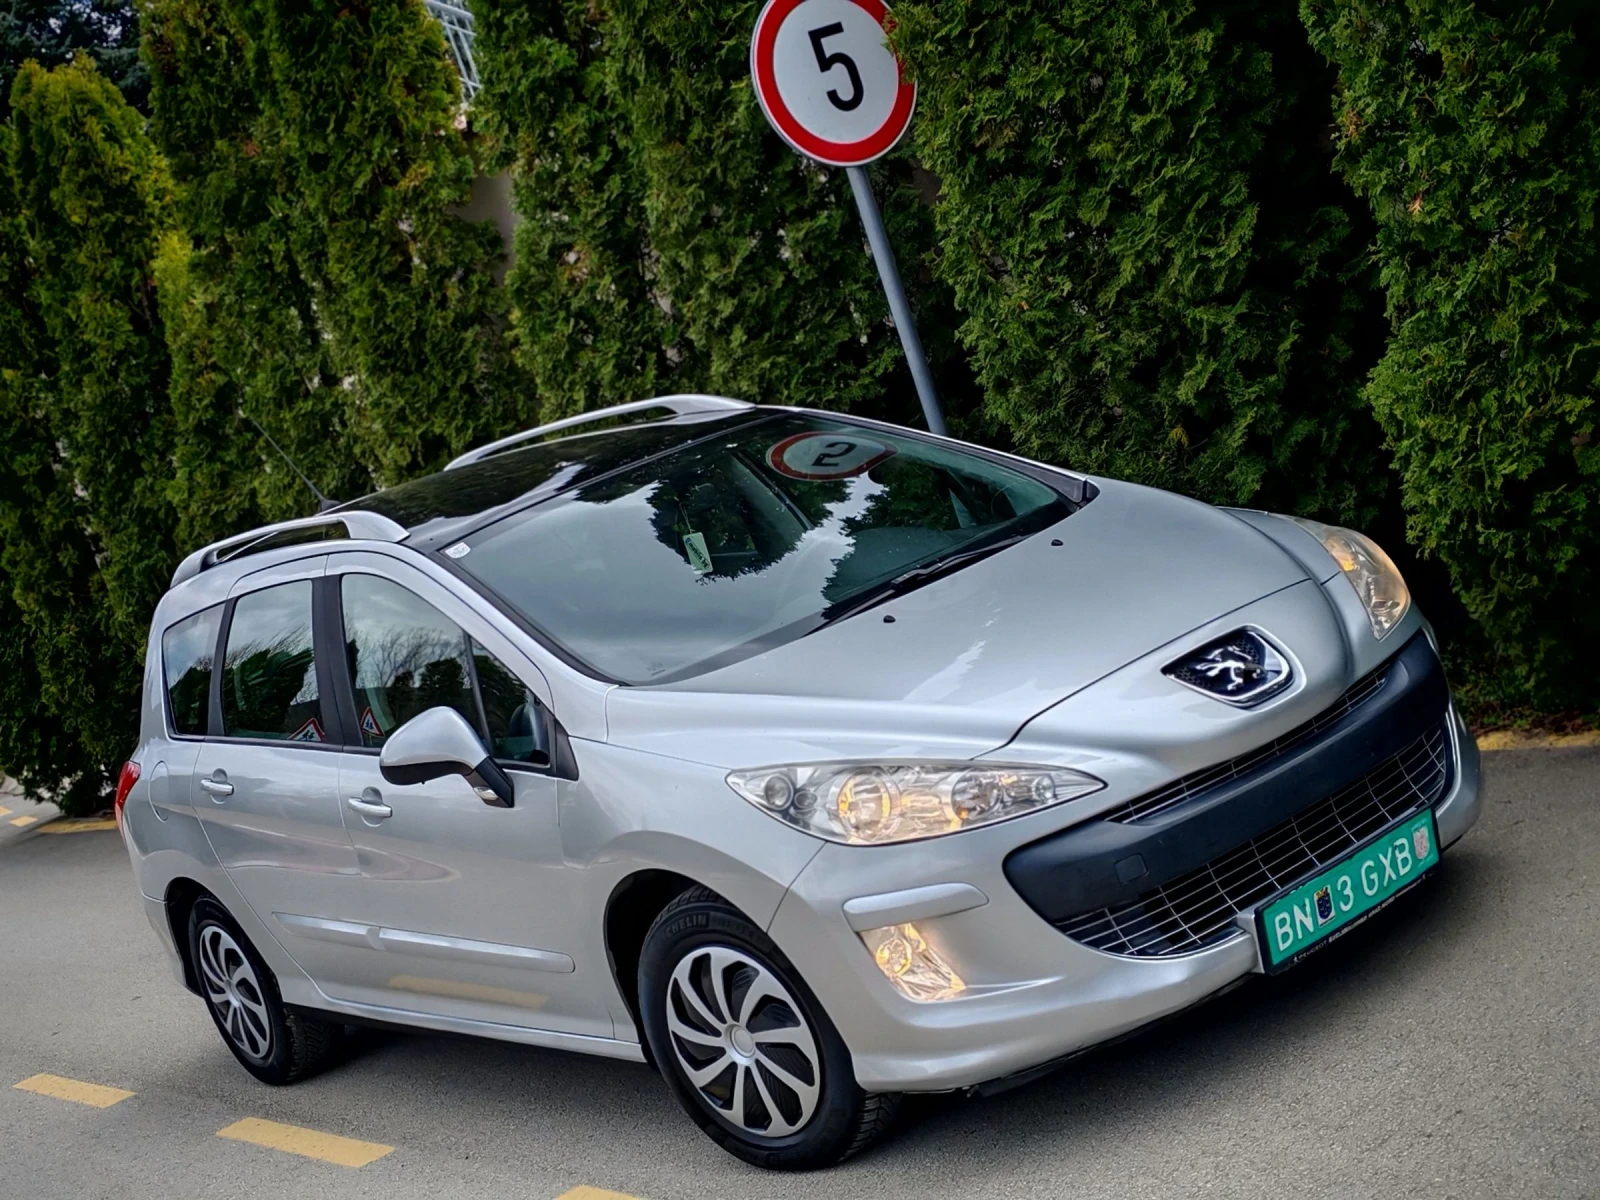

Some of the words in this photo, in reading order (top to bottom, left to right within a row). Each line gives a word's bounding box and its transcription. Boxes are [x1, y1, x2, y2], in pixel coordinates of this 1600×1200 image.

[808, 21, 865, 112] 5
[665, 914, 708, 938] CHELIN
[1274, 897, 1315, 952] BN
[1337, 875, 1355, 912] 3
[1361, 837, 1413, 897] GXB
